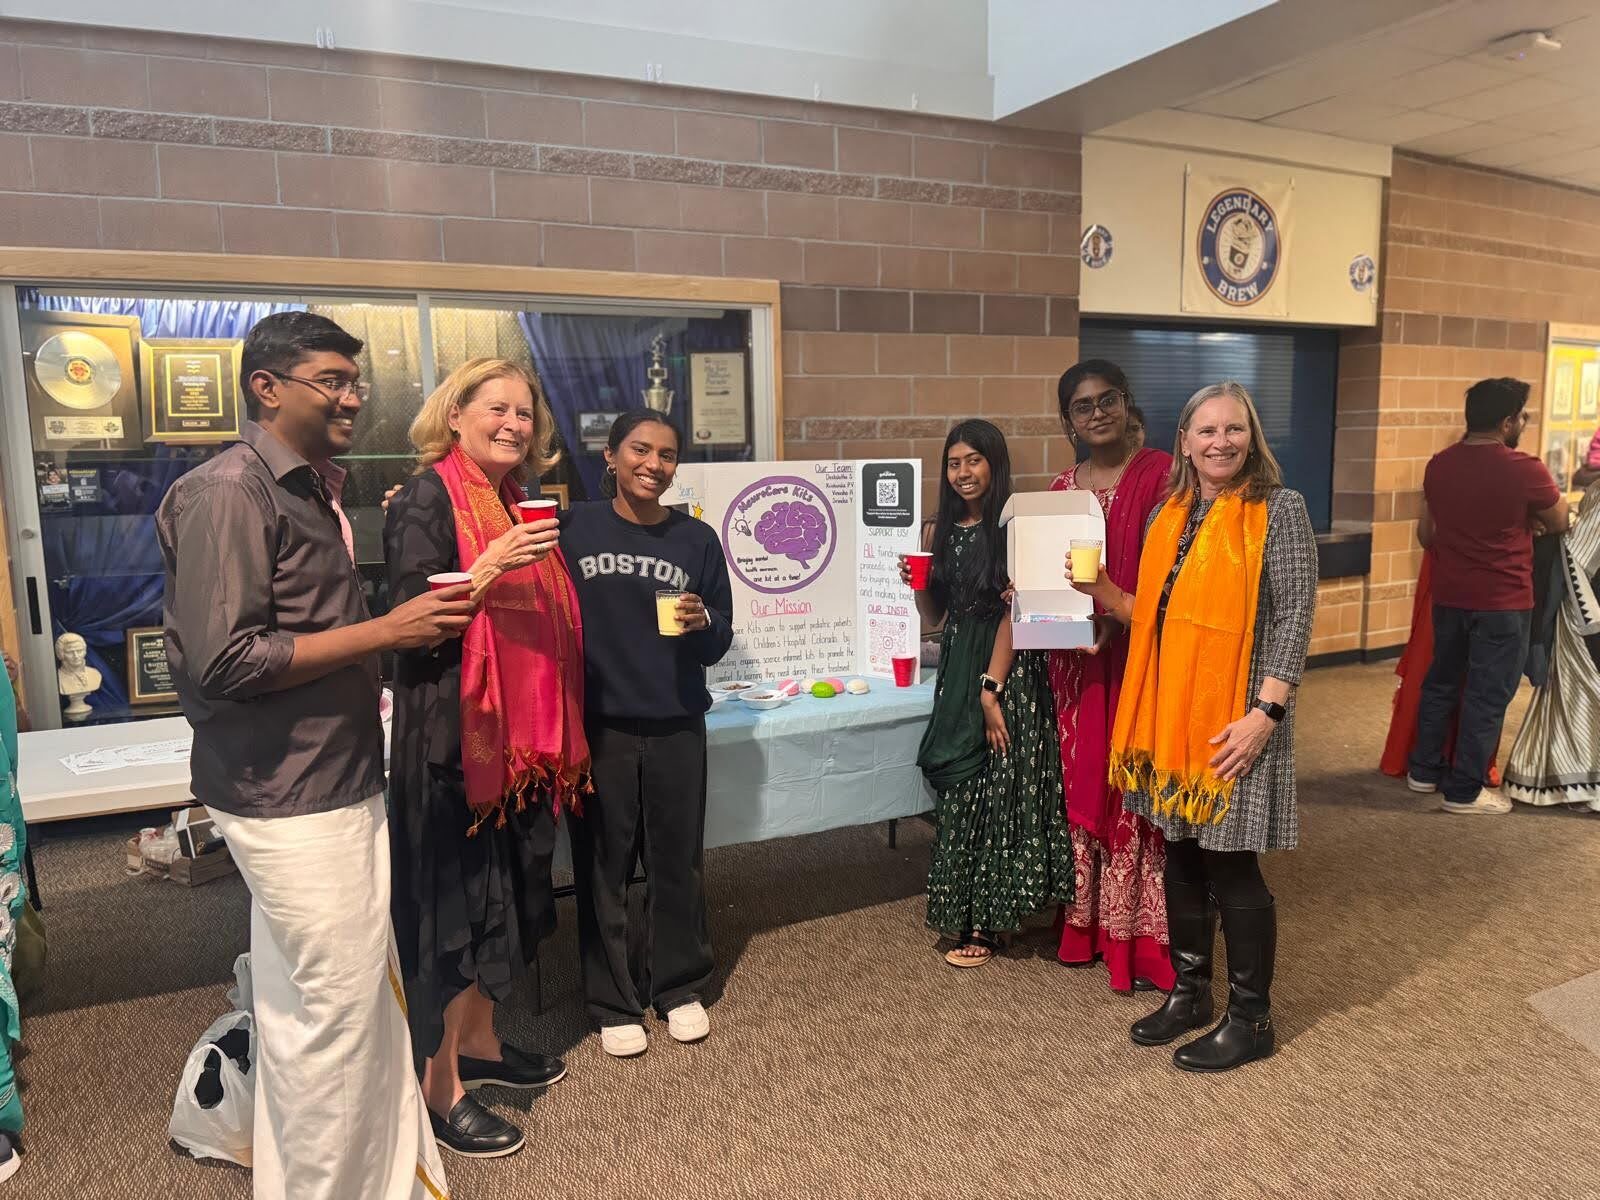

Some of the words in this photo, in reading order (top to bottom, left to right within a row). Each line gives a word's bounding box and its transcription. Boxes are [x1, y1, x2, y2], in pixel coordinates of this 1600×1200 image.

[1206, 196, 1274, 233] LEGENDARY
[1217, 279, 1259, 301] BREW
[815, 464, 828, 473] Our
[833, 463, 852, 472] Team
[737, 486, 788, 513] NeuroCare
[792, 485, 813, 502] Kits
[869, 527, 893, 537] SUPPORT
[864, 543, 875, 558] ALL
[578, 552, 690, 591] BOSTON
[751, 600, 770, 617] Our
[775, 598, 811, 616] Mission
[867, 604, 882, 614] OUR
[887, 605, 909, 615] INSTA
[747, 622, 761, 634] Kits
[765, 624, 775, 632] aim
[784, 635, 806, 649] Hospital
